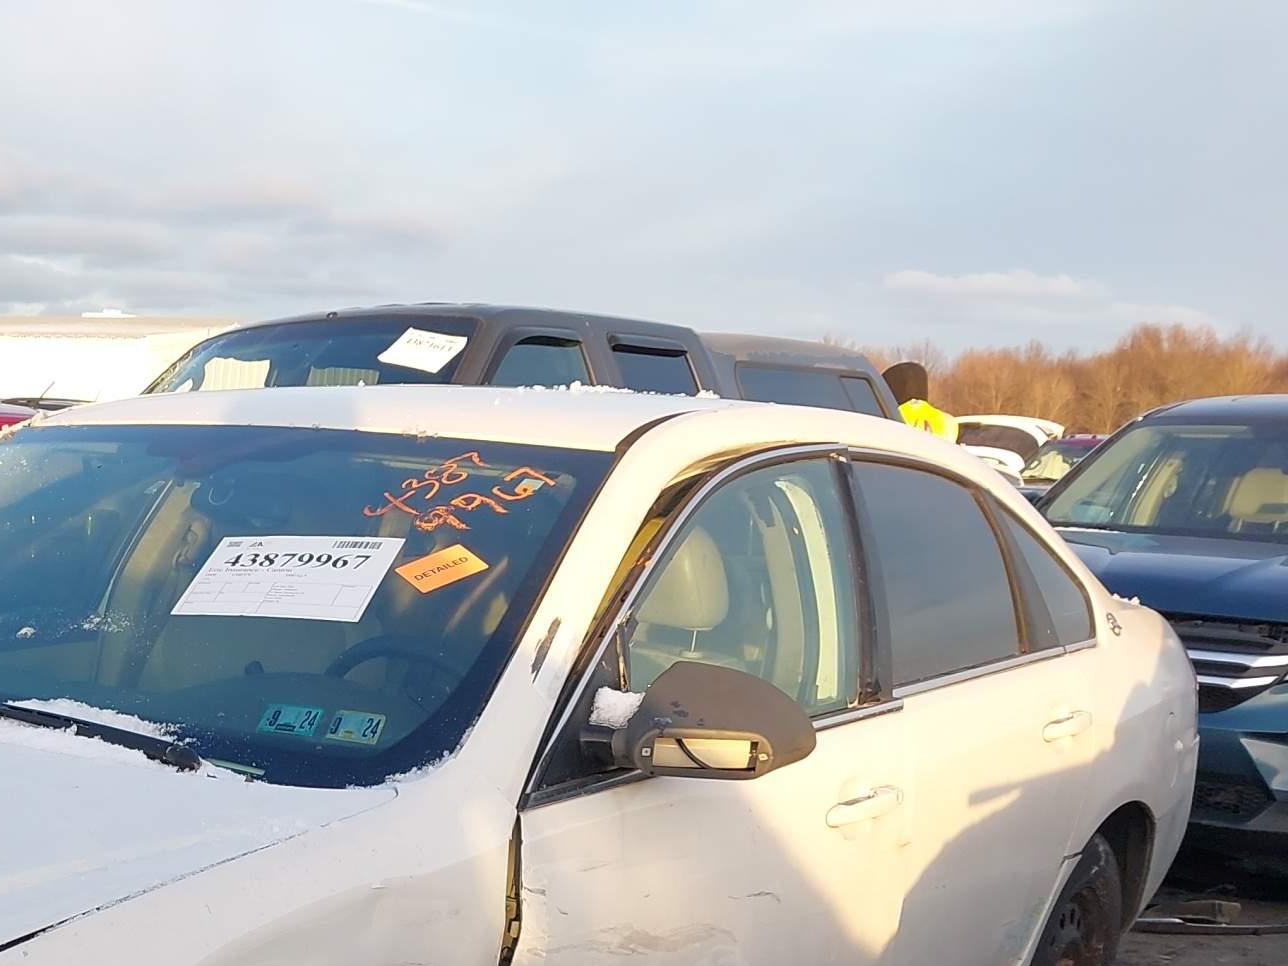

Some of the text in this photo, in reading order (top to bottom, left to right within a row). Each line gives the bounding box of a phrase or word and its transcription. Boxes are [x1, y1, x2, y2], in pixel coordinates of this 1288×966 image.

[223, 552, 372, 571] 43879967
[414, 556, 469, 581] DETAILED
[299, 710, 320, 730] 24
[361, 717, 381, 738] 24
